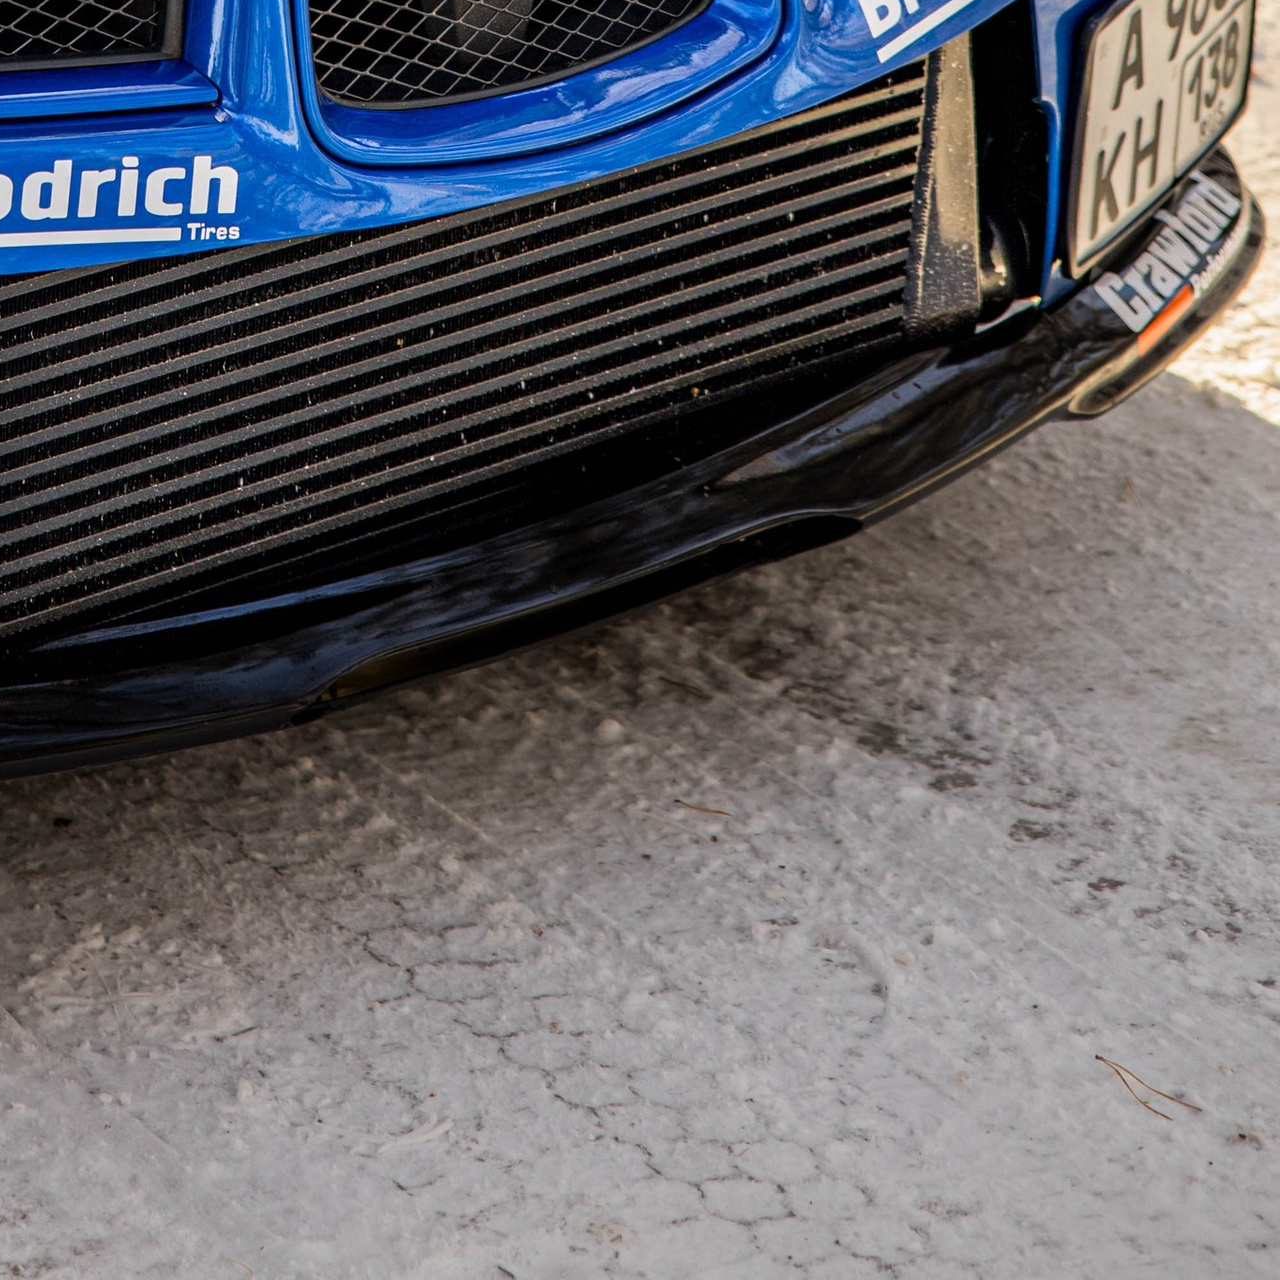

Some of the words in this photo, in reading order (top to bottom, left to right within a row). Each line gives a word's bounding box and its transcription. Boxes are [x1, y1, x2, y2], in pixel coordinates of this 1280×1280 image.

[1111, 8, 1144, 111] A
[1090, 97, 1164, 241] KH
[1187, 19, 1240, 123] 138
[186, 222, 241, 241] Tires
[1093, 169, 1243, 333] Crawford
